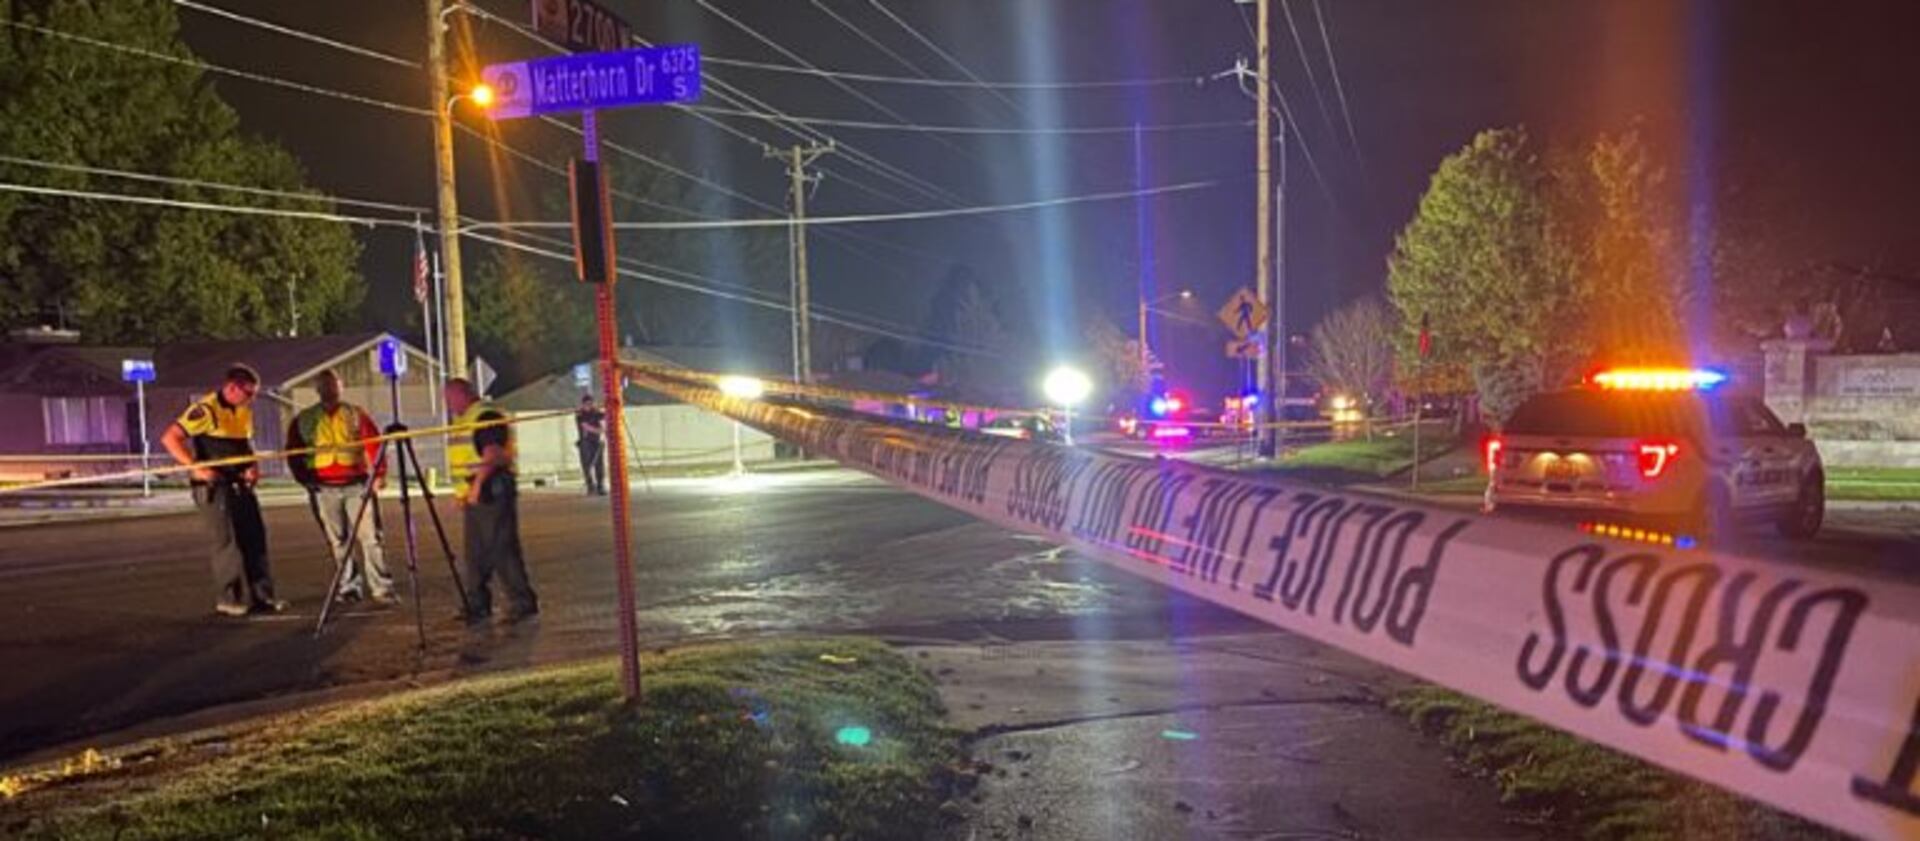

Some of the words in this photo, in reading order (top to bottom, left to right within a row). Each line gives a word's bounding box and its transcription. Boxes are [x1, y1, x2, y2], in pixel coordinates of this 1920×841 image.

[534, 63, 628, 104] Matterhorn
[635, 55, 655, 94] Dr
[661, 47, 696, 74] 6375
[673, 76, 687, 97] S
[1171, 477, 1281, 590] LINE
[1253, 493, 1471, 648] POLICE
[1518, 544, 1868, 772] CROSS
